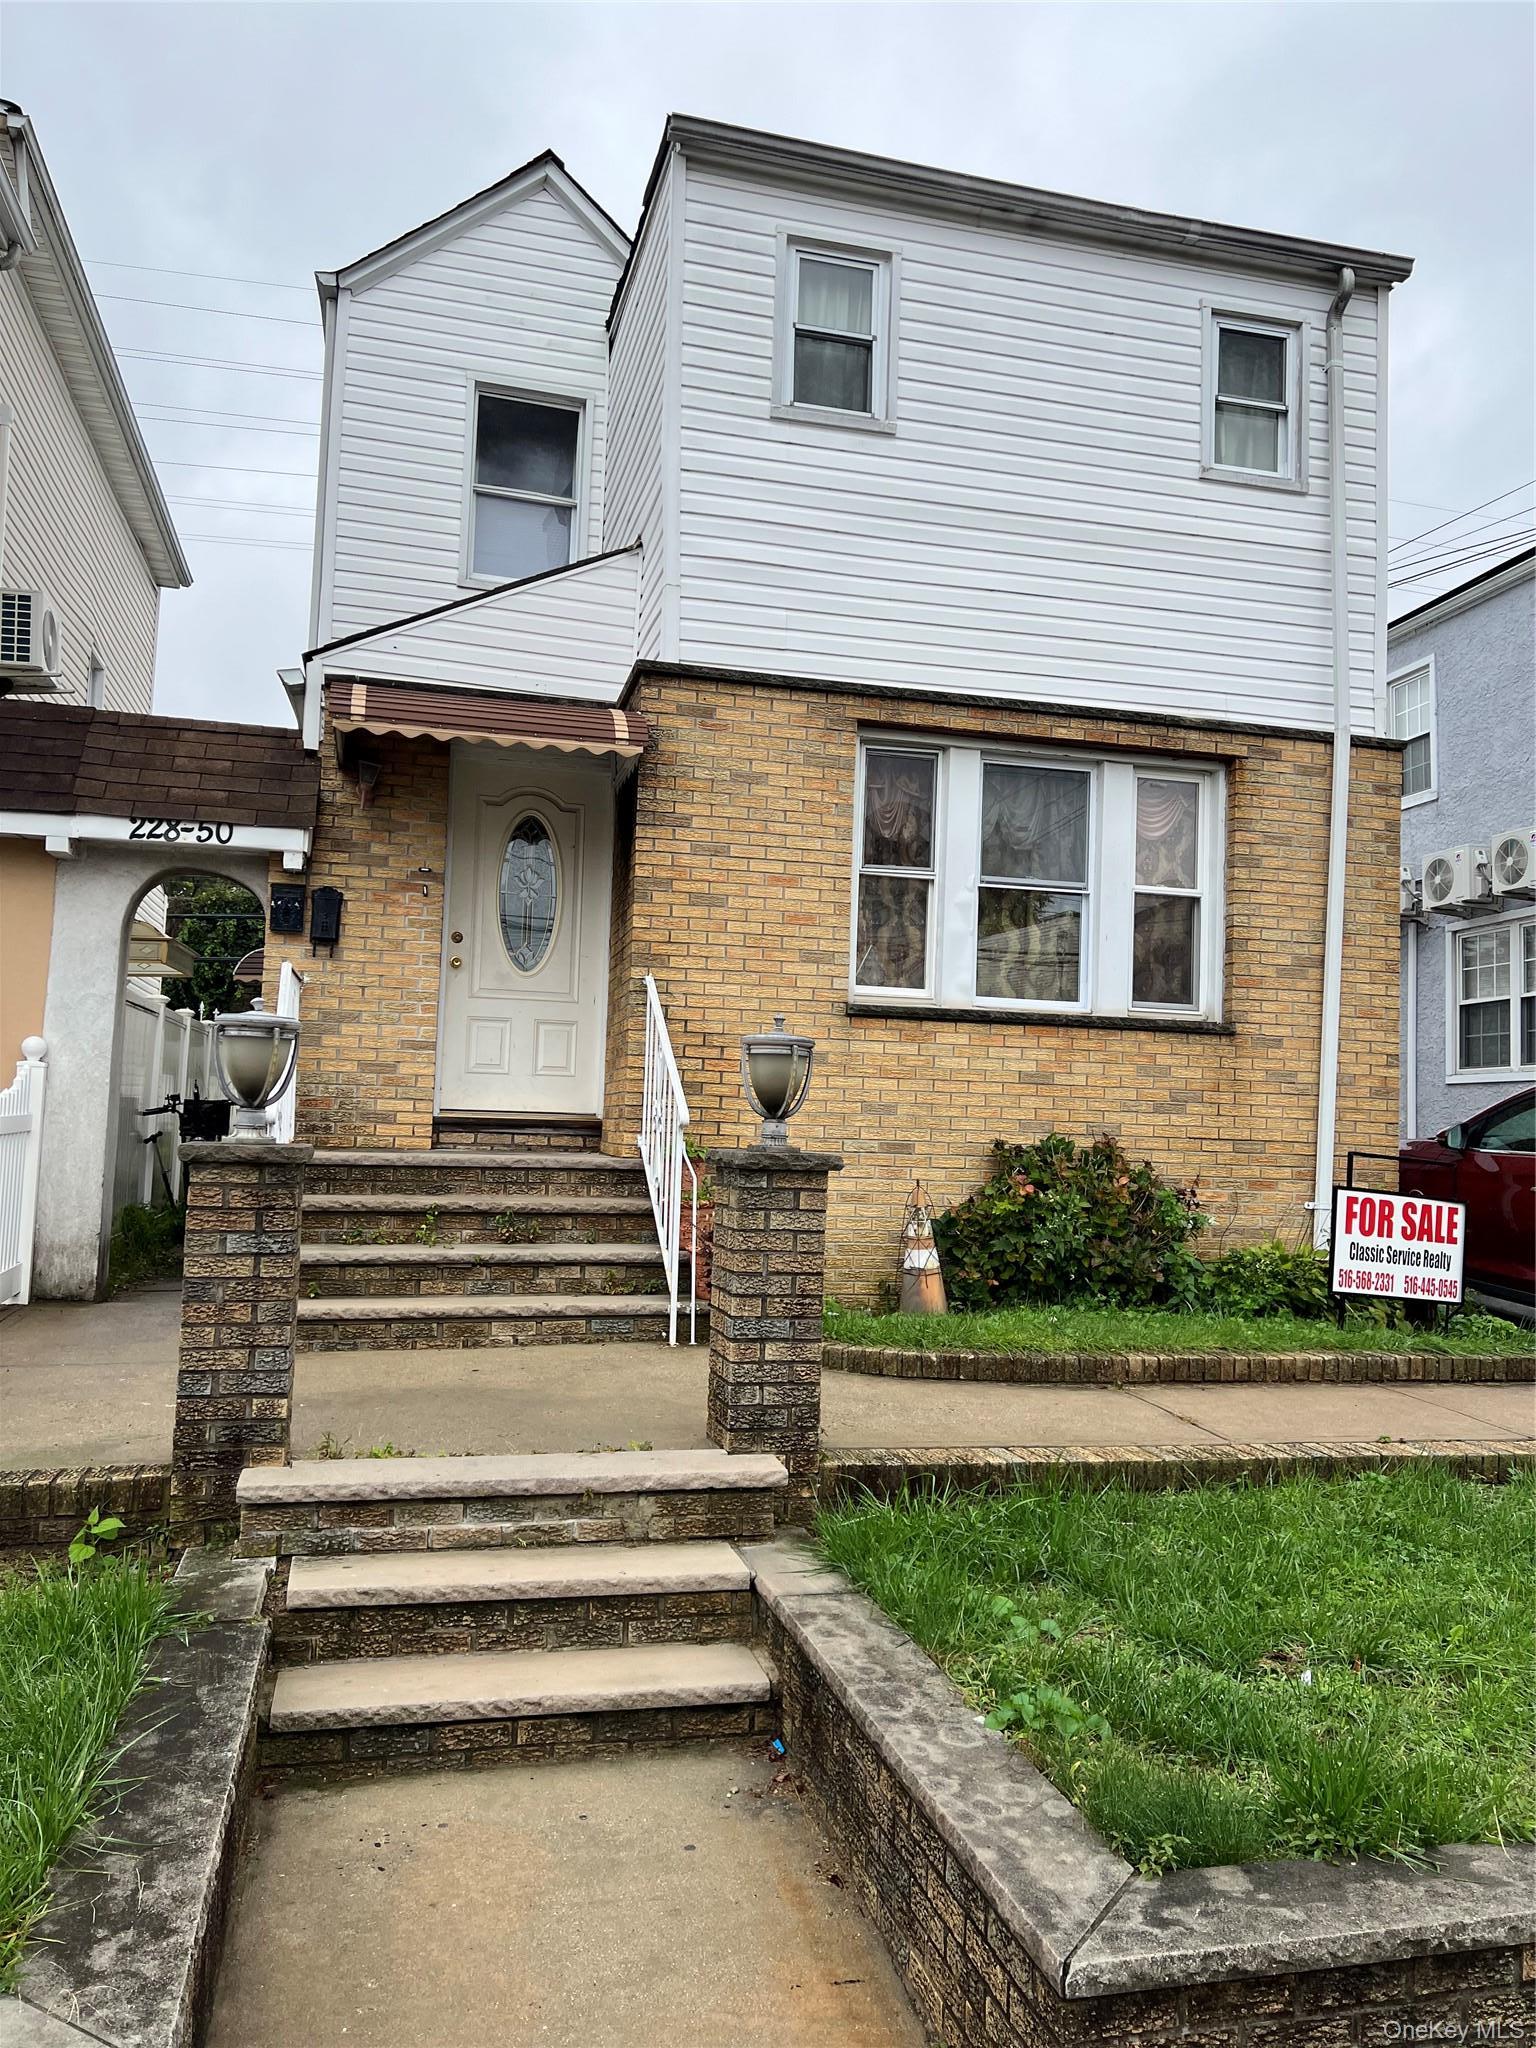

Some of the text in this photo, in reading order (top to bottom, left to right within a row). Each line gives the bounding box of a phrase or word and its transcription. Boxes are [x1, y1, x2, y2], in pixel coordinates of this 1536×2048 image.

[129, 817, 233, 844] 228-50
[1345, 1196, 1458, 1244] FOR SALE
[1349, 1242, 1451, 1272] Classic Service Realty
[1338, 1269, 1458, 1298] 516-568-2331 516-445-0545
